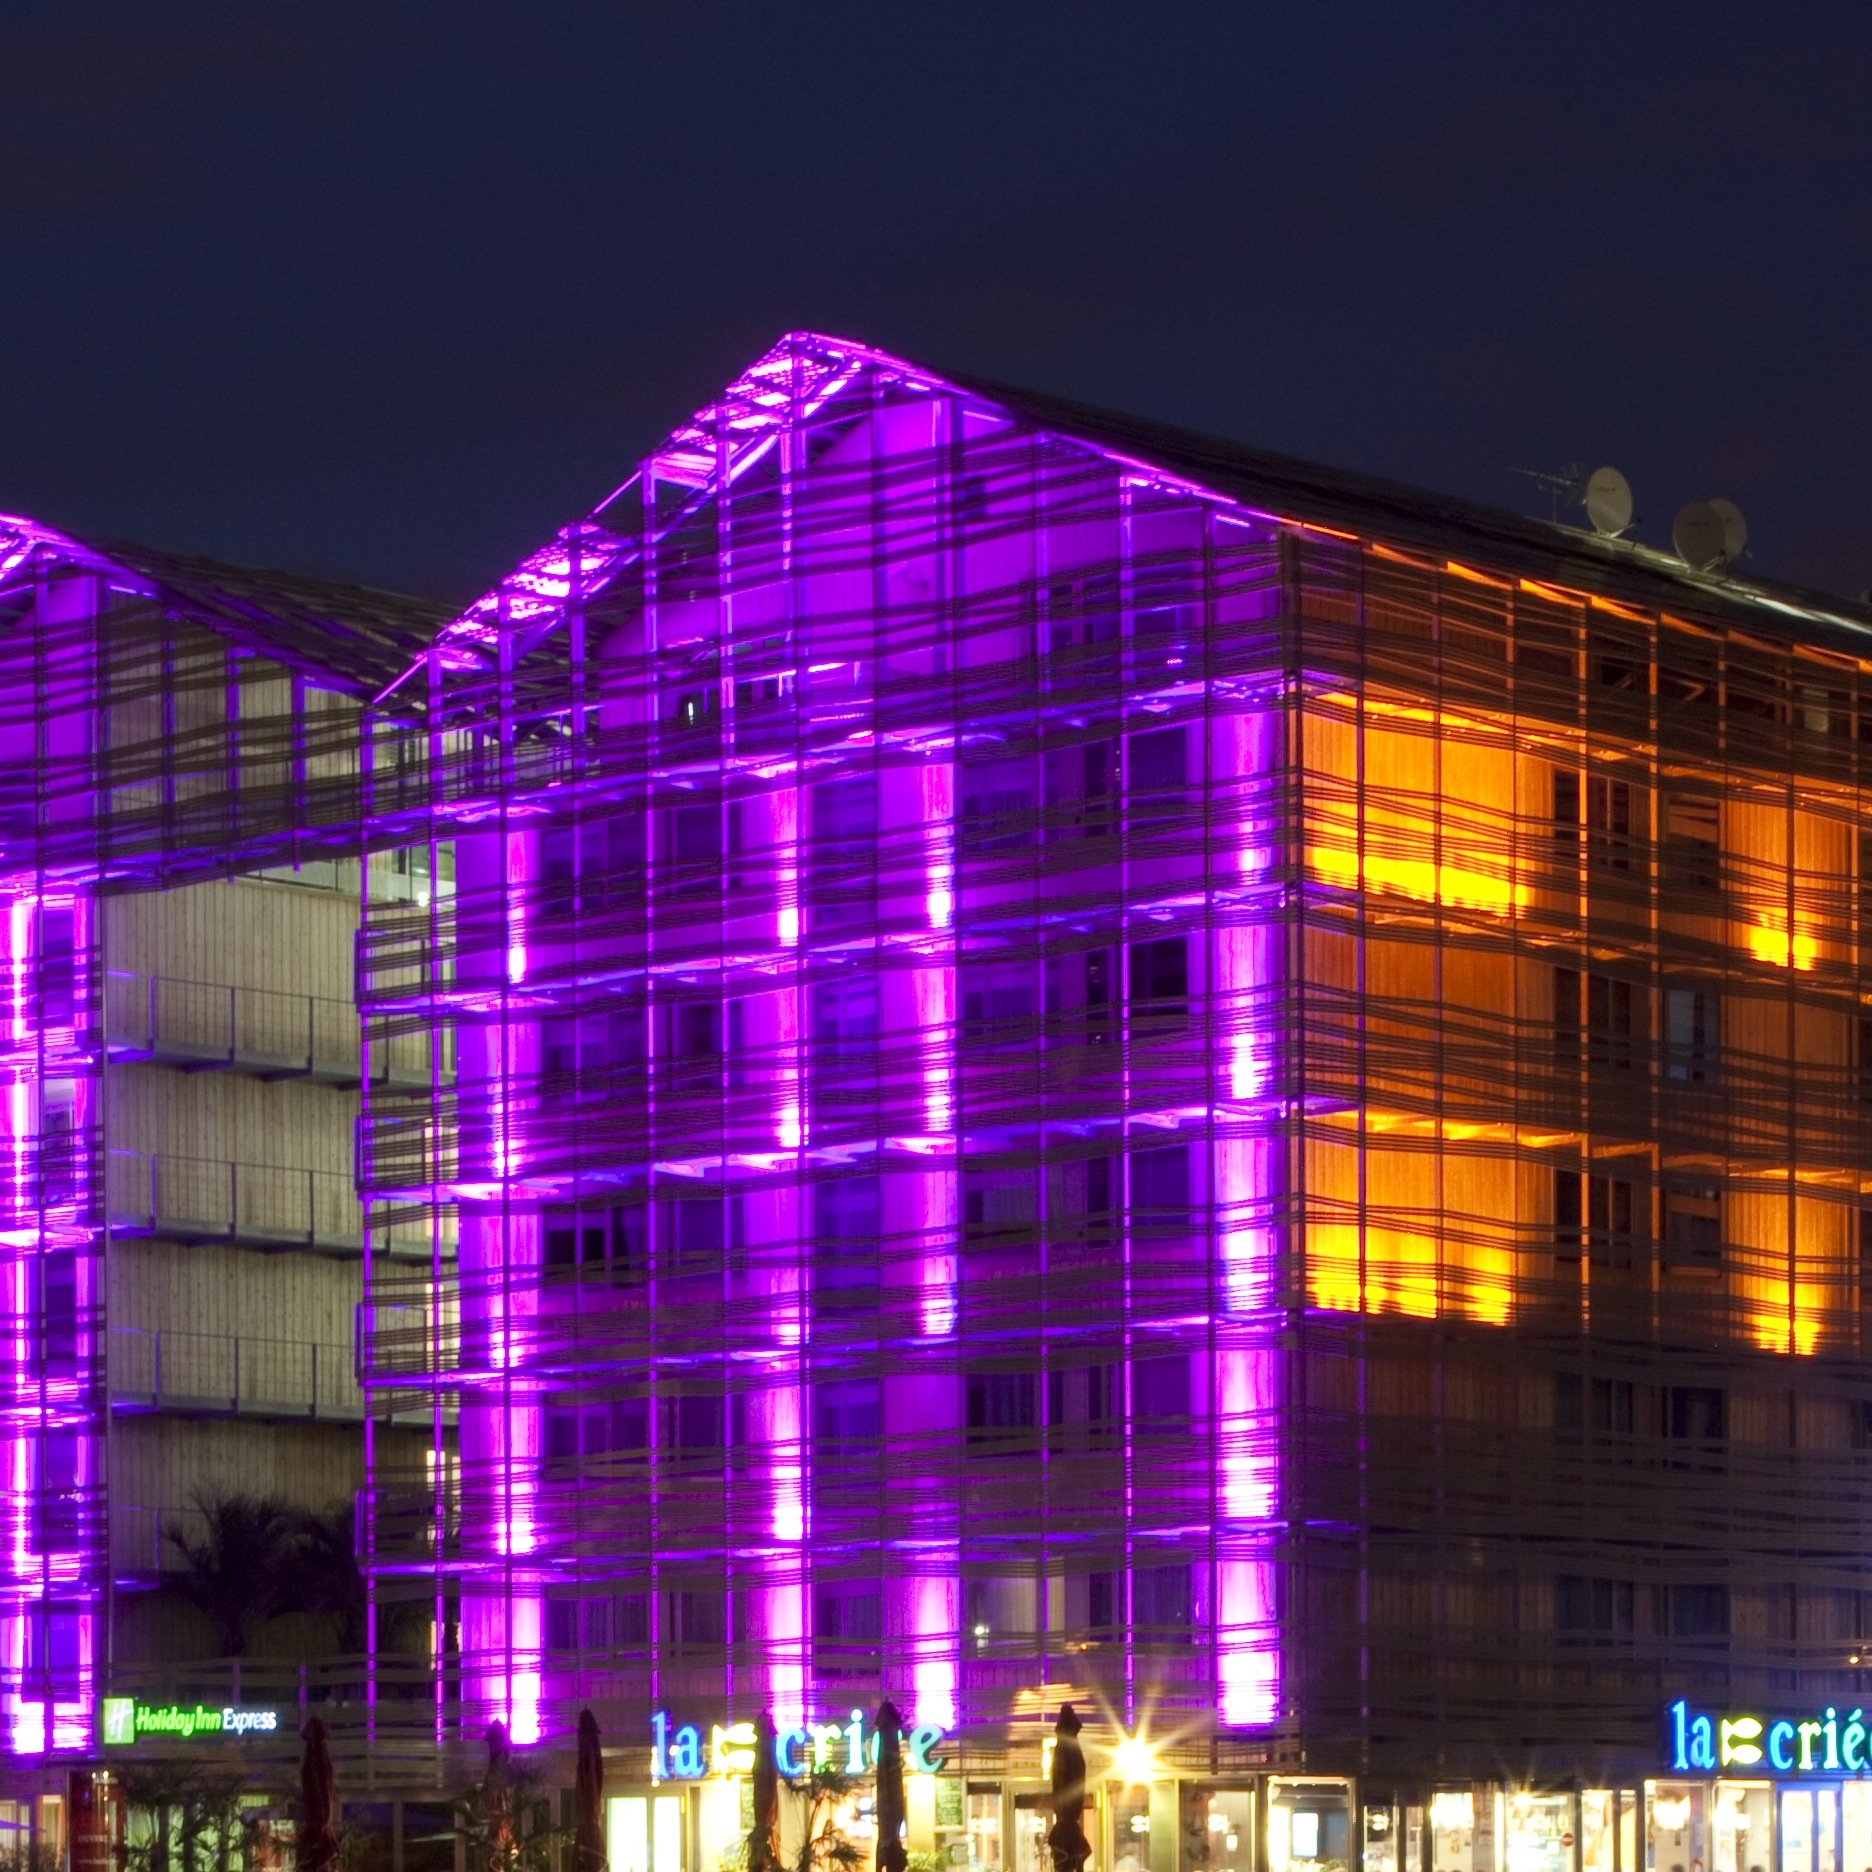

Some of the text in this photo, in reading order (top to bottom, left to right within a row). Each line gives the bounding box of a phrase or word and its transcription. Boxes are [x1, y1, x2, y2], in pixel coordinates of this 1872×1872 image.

[136, 1704, 277, 1737] Holiday Inn Express
[651, 1709, 706, 1778] la
[1672, 1700, 1715, 1770] la
